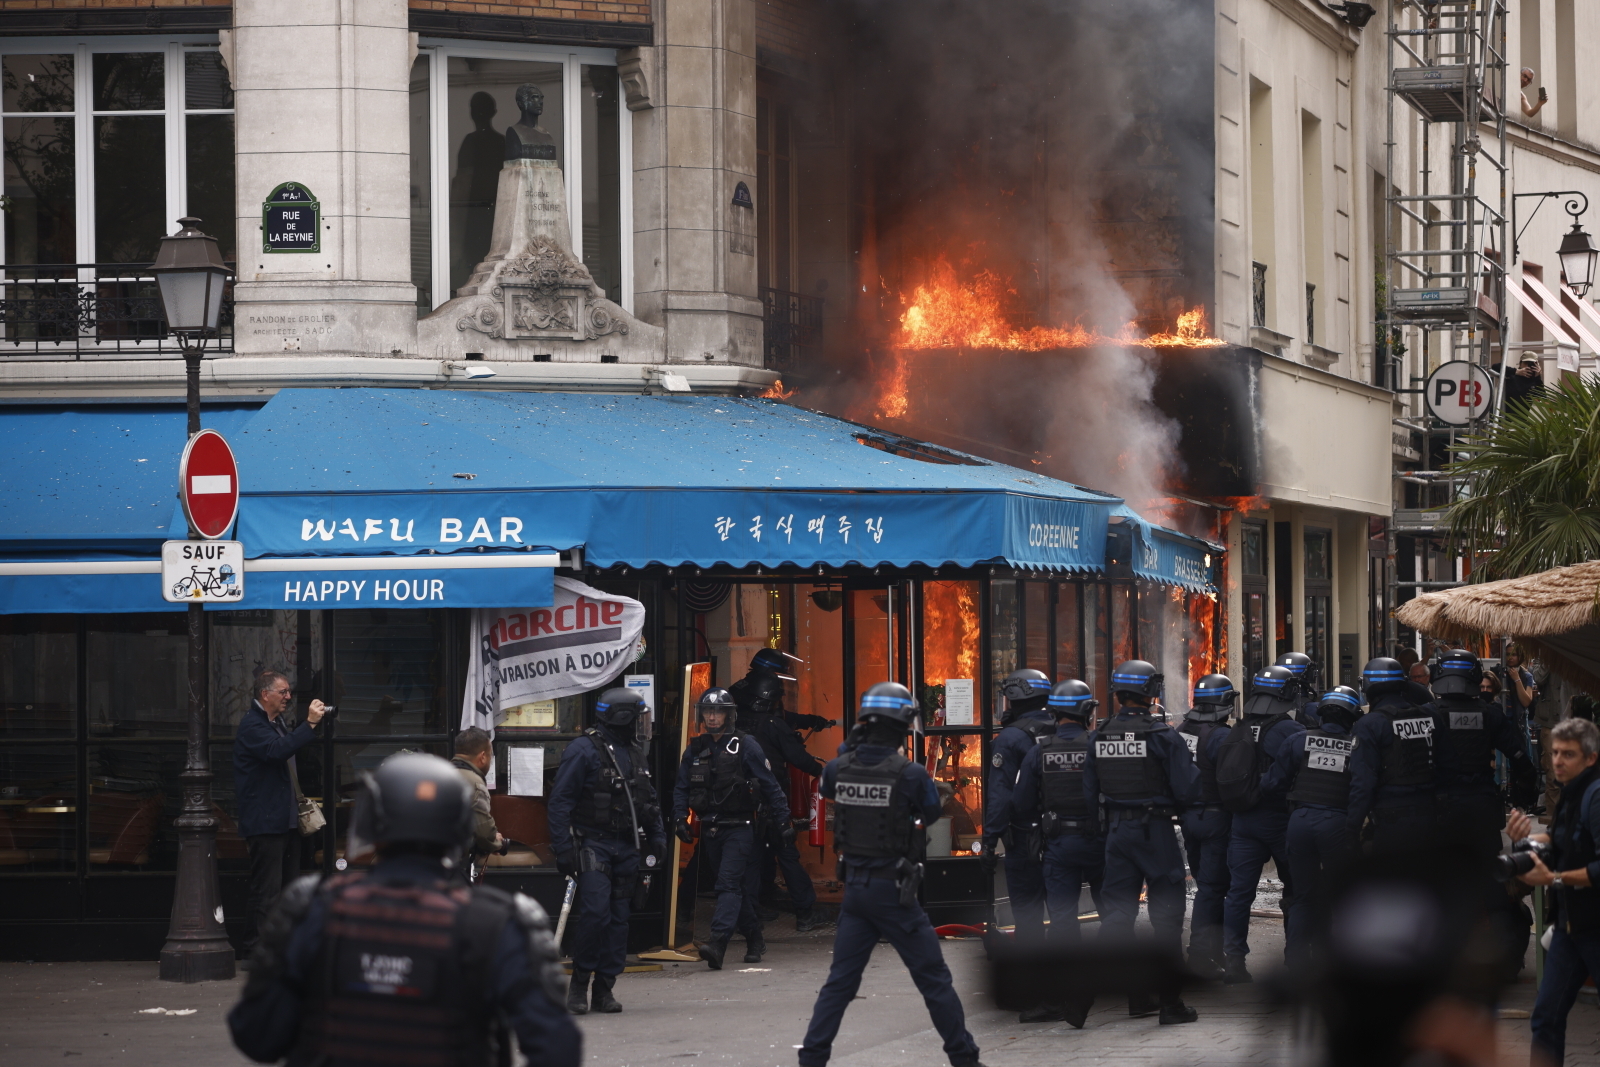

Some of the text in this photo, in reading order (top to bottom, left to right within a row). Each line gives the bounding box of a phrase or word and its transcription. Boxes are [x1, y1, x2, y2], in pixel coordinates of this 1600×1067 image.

[282, 211, 300, 220] RUE
[269, 232, 314, 242] LA REYNIE
[249, 315, 286, 324] RANDON
[298, 315, 336, 323] GROLIER
[1434, 378, 1482, 407] PB
[301, 516, 524, 543] WAFU BAR
[1028, 523, 1080, 550] COREENNE
[183, 545, 226, 560] SAUF
[1143, 548, 1158, 571] BAR
[284, 578, 445, 602] HAPPY HOUR
[565, 653, 578, 672] À
[1395, 719, 1432, 738] POLICE
[1099, 742, 1143, 756] POLICE
[1307, 736, 1352, 752] POLICE
[1317, 756, 1336, 767] 123
[838, 784, 888, 799] POLICE
